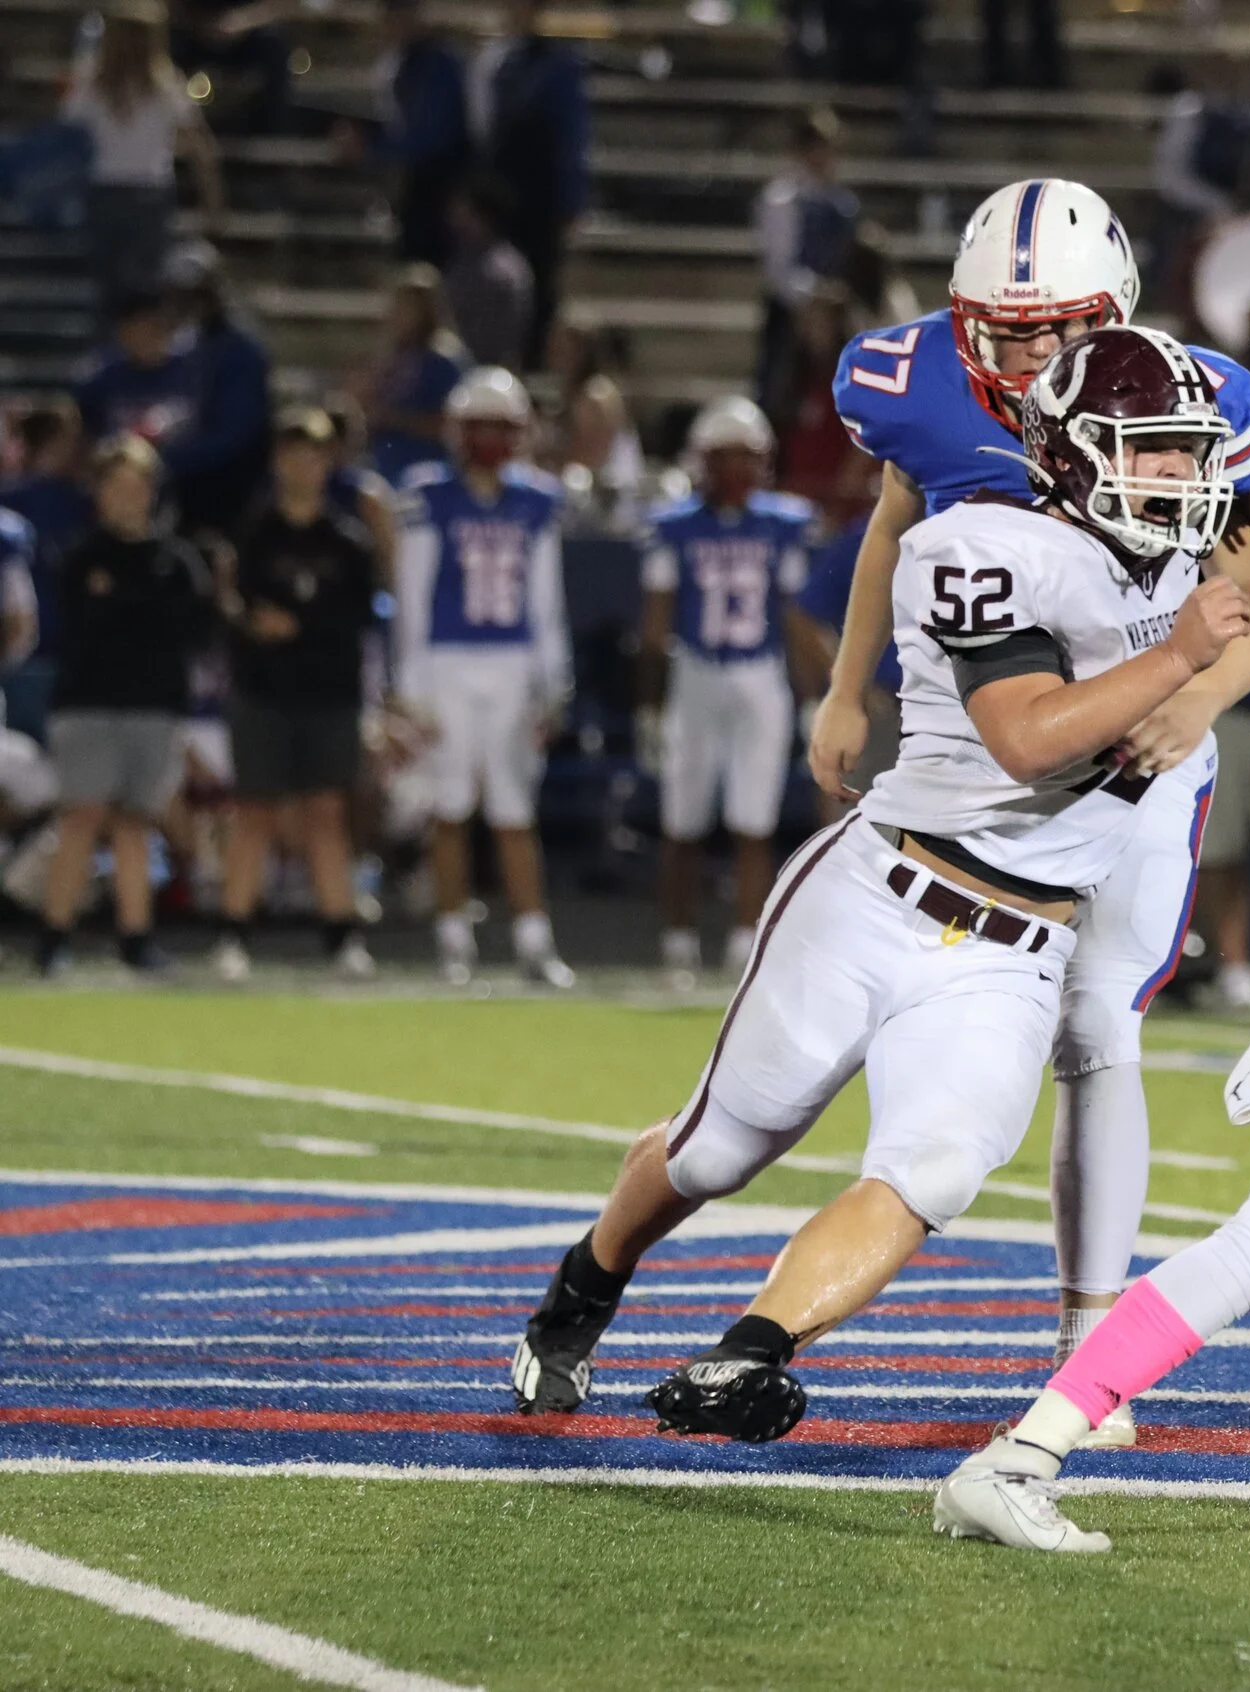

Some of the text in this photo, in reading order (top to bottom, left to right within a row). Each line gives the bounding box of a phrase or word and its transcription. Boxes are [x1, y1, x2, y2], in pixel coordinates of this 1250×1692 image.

[1003, 288, 1040, 298] Riddell
[852, 326, 921, 396] 77
[931, 565, 1015, 632] 52
